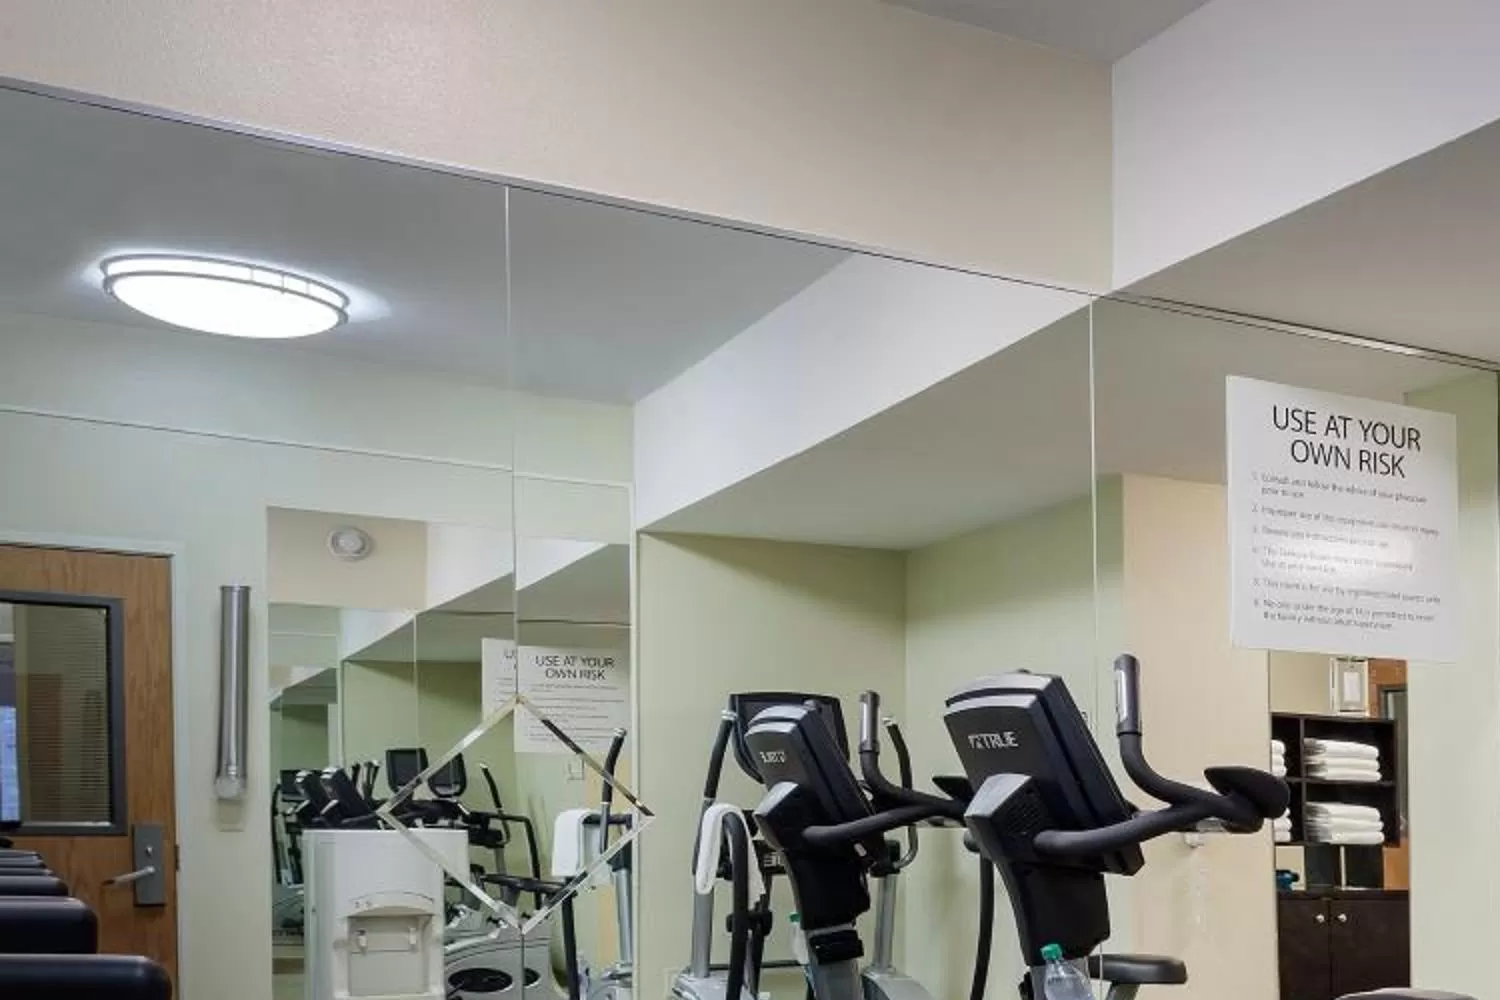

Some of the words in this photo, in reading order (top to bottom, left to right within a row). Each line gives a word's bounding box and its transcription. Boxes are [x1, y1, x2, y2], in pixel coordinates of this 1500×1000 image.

[1273, 404, 1317, 435] USE
[1324, 415, 1353, 440] AT
[1358, 419, 1421, 452] YOUR
[1291, 439, 1351, 470] OWN
[1359, 449, 1405, 479] RISK
[535, 655, 560, 667] USE
[564, 655, 577, 667] AT
[581, 657, 614, 669] YOUR
[545, 668, 577, 679] OWN
